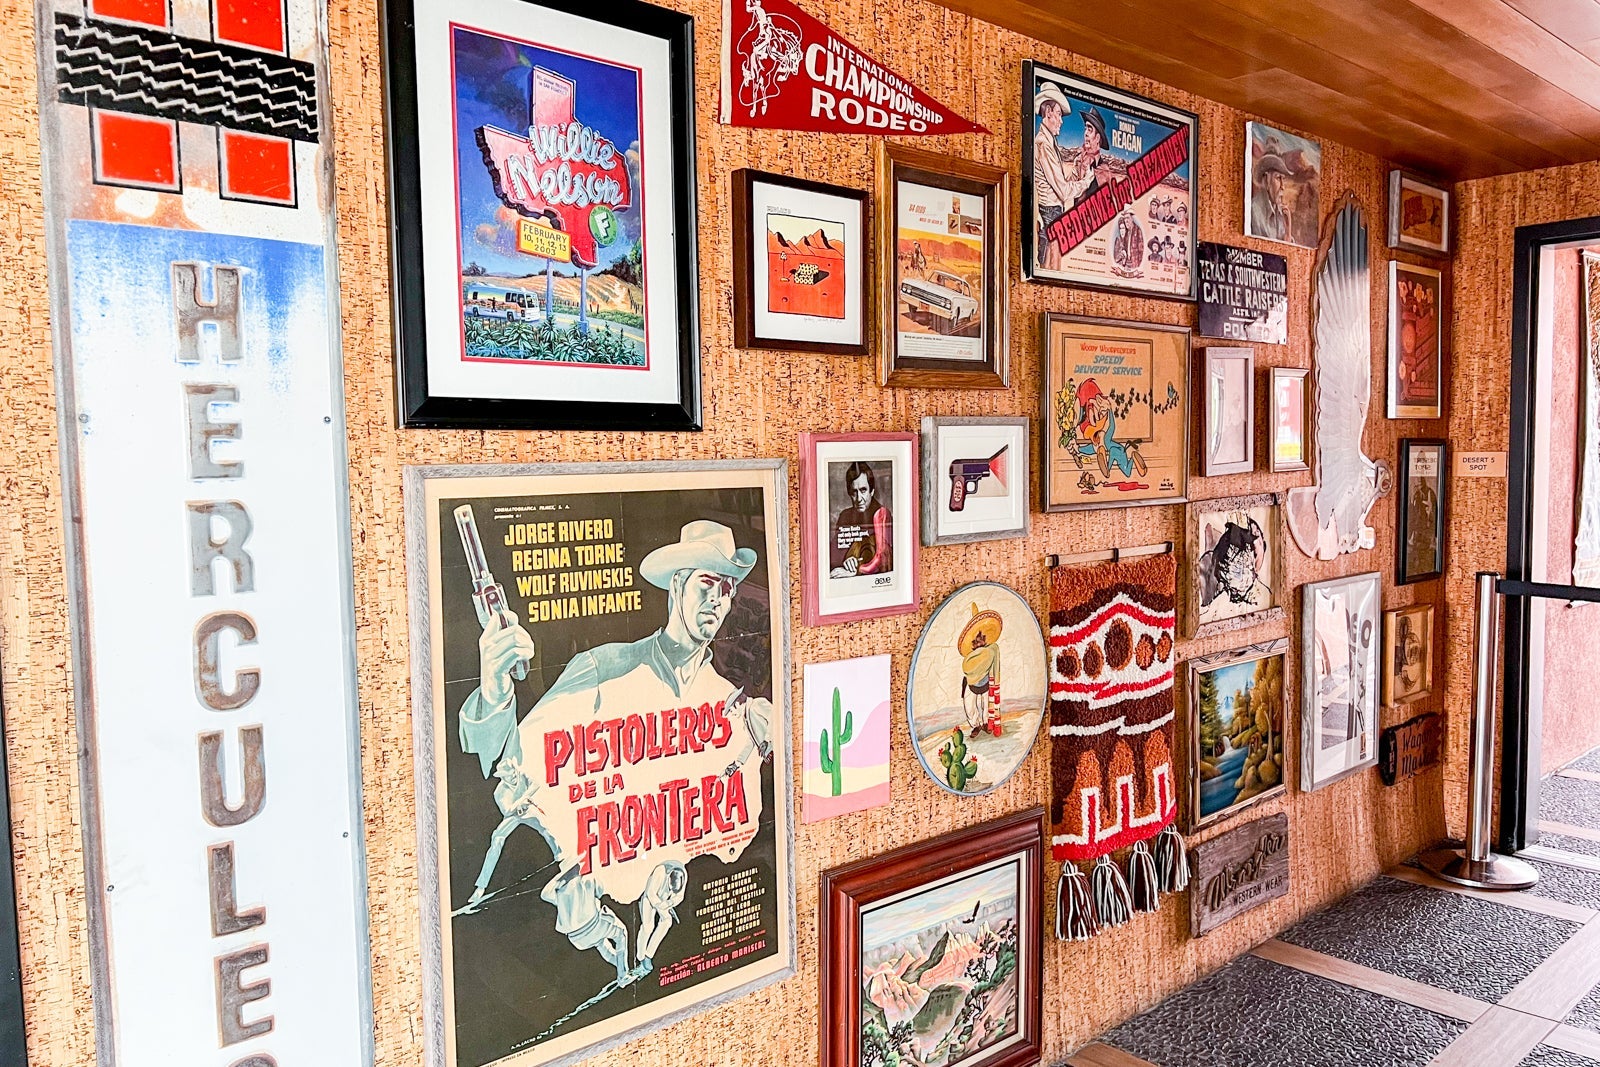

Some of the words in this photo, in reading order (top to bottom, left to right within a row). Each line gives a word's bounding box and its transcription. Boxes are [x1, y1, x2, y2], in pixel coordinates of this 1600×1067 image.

[828, 35, 914, 98] INTERNATIONAL
[805, 42, 944, 124] CHAMPIONSHIP
[810, 88, 927, 132] RODEO
[529, 122, 616, 170] Willie
[1112, 129, 1142, 154] REAGAN
[507, 162, 624, 208] Nelson
[1111, 175, 1132, 213] for
[524, 224, 566, 243] FEBRUARY
[524, 234, 533, 243] 10,
[536, 238, 544, 246] 11,
[548, 242, 557, 250] 12,
[560, 244, 566, 252] 13
[534, 244, 556, 256] 2003
[1200, 260, 1226, 282] TEXAS
[1228, 264, 1234, 284] &
[1235, 266, 1286, 292] SOUTHWESTERN
[1204, 282, 1242, 306] CATTLE
[1074, 365, 1110, 374] DELIVERY
[1112, 366, 1142, 376] SERVICE
[1094, 355, 1124, 364] SPEEDY
[504, 522, 556, 546] JORGE
[558, 518, 614, 542] RIVERO
[512, 546, 572, 572] REGINA
[574, 542, 624, 566] TORNE
[516, 573, 556, 598] WOLF
[560, 566, 634, 594] RUVINSKIS
[528, 597, 580, 623] SONIA
[582, 590, 642, 616] INFANTE
[171, 261, 279, 1067] HERCULE
[544, 700, 732, 787] PISTOLEROS
[568, 780, 598, 803] DE
[603, 772, 624, 794] LA
[576, 770, 748, 876] FRONTERA
[703, 876, 728, 891] ANTONIO
[711, 886, 724, 896] JOSE
[1233, 882, 1262, 906] WESTERN
[1266, 876, 1283, 892] WEAR
[696, 902, 724, 917] FEDERICO
[741, 888, 765, 902] CASTILLO
[705, 892, 730, 906] RICARDO
[712, 906, 734, 919] CARLOS
[736, 900, 750, 910] LEON
[701, 916, 726, 930] AGUSTIN
[702, 922, 732, 938] SALVADOR
[702, 930, 732, 946] FERNANDO
[697, 954, 728, 972] ALBERTO
[732, 940, 766, 959] MARISCAL
